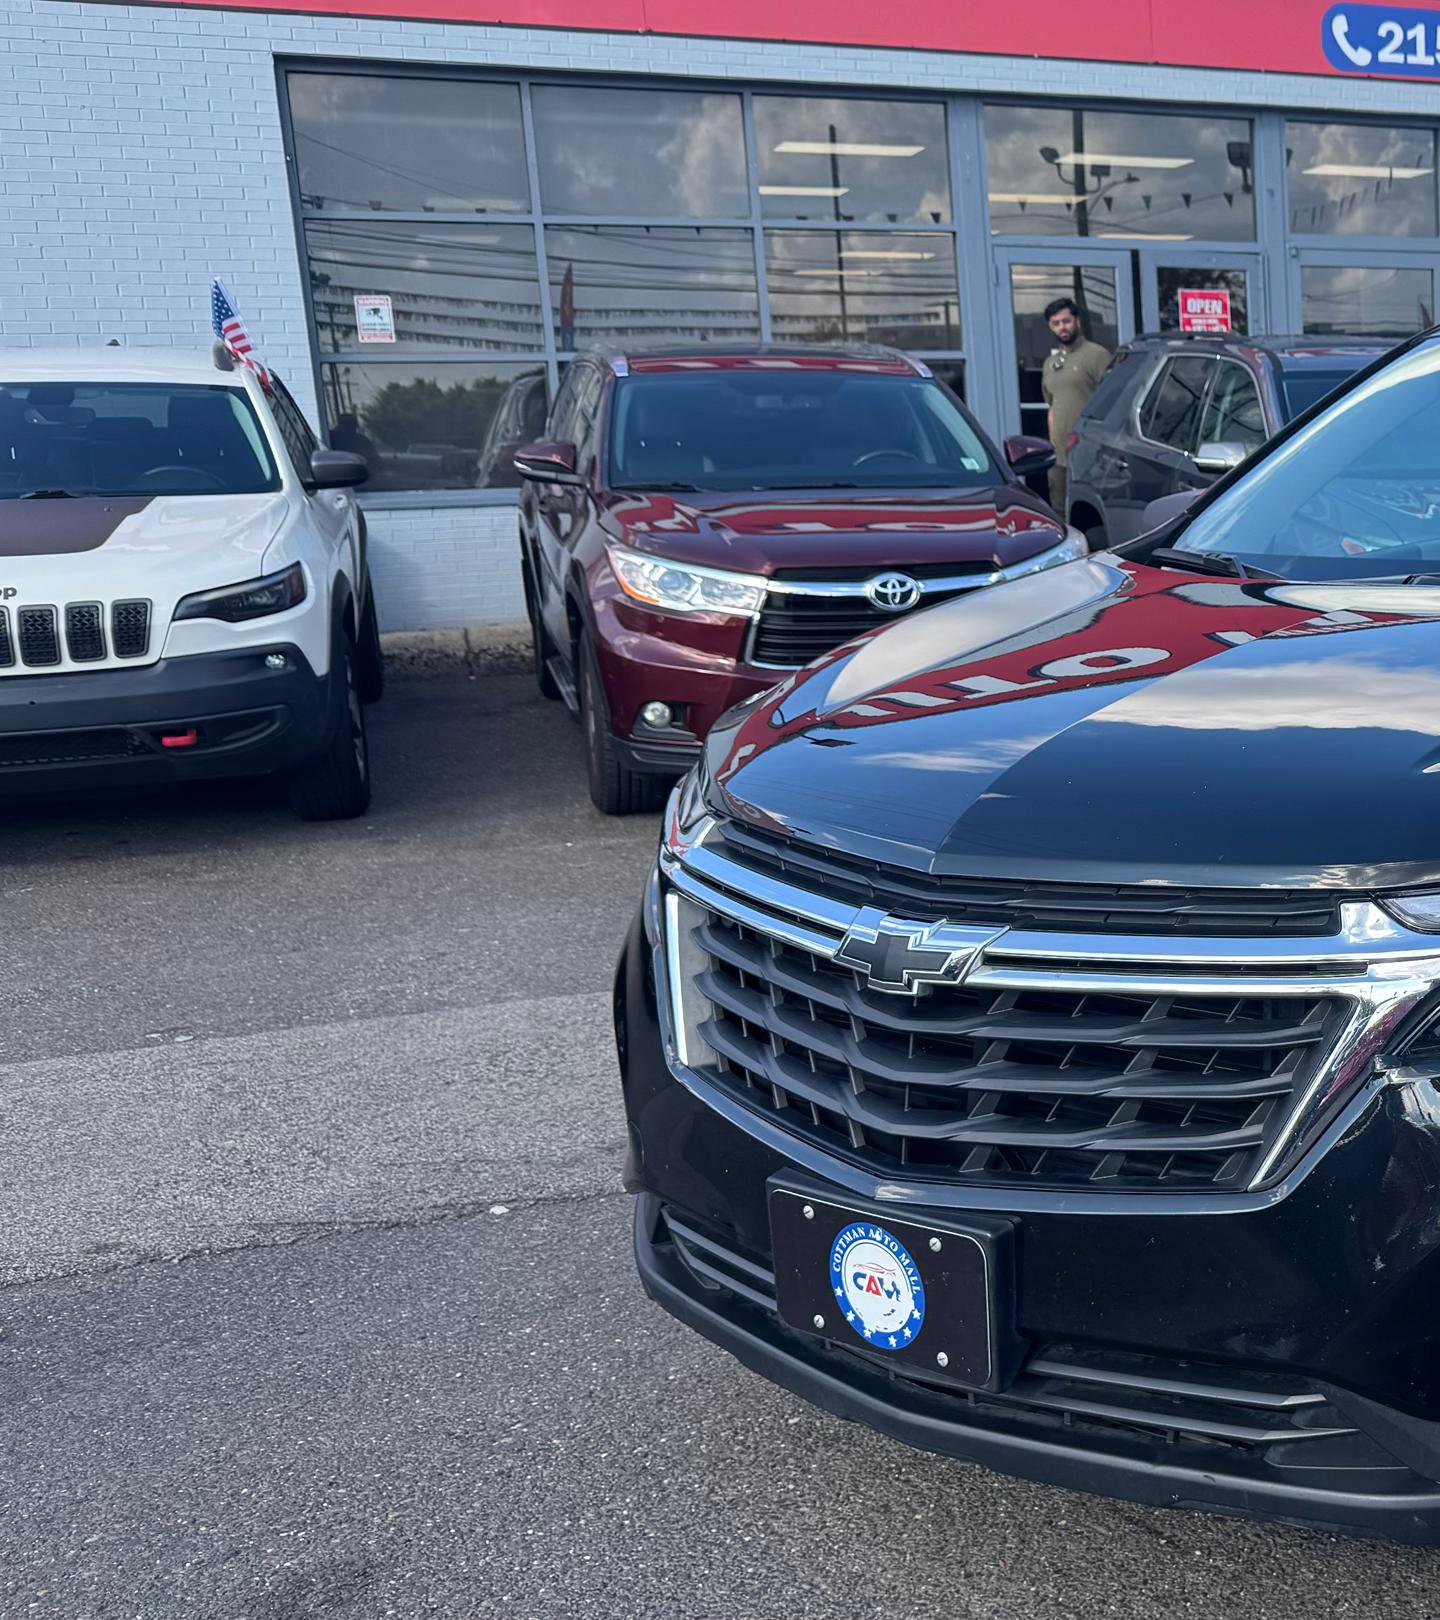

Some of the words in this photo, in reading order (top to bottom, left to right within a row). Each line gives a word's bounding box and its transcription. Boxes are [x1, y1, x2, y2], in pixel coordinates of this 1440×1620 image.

[1187, 298, 1223, 315] OPEN
[832, 1227, 866, 1272] COTTMAN
[899, 1253, 921, 1295] MALL
